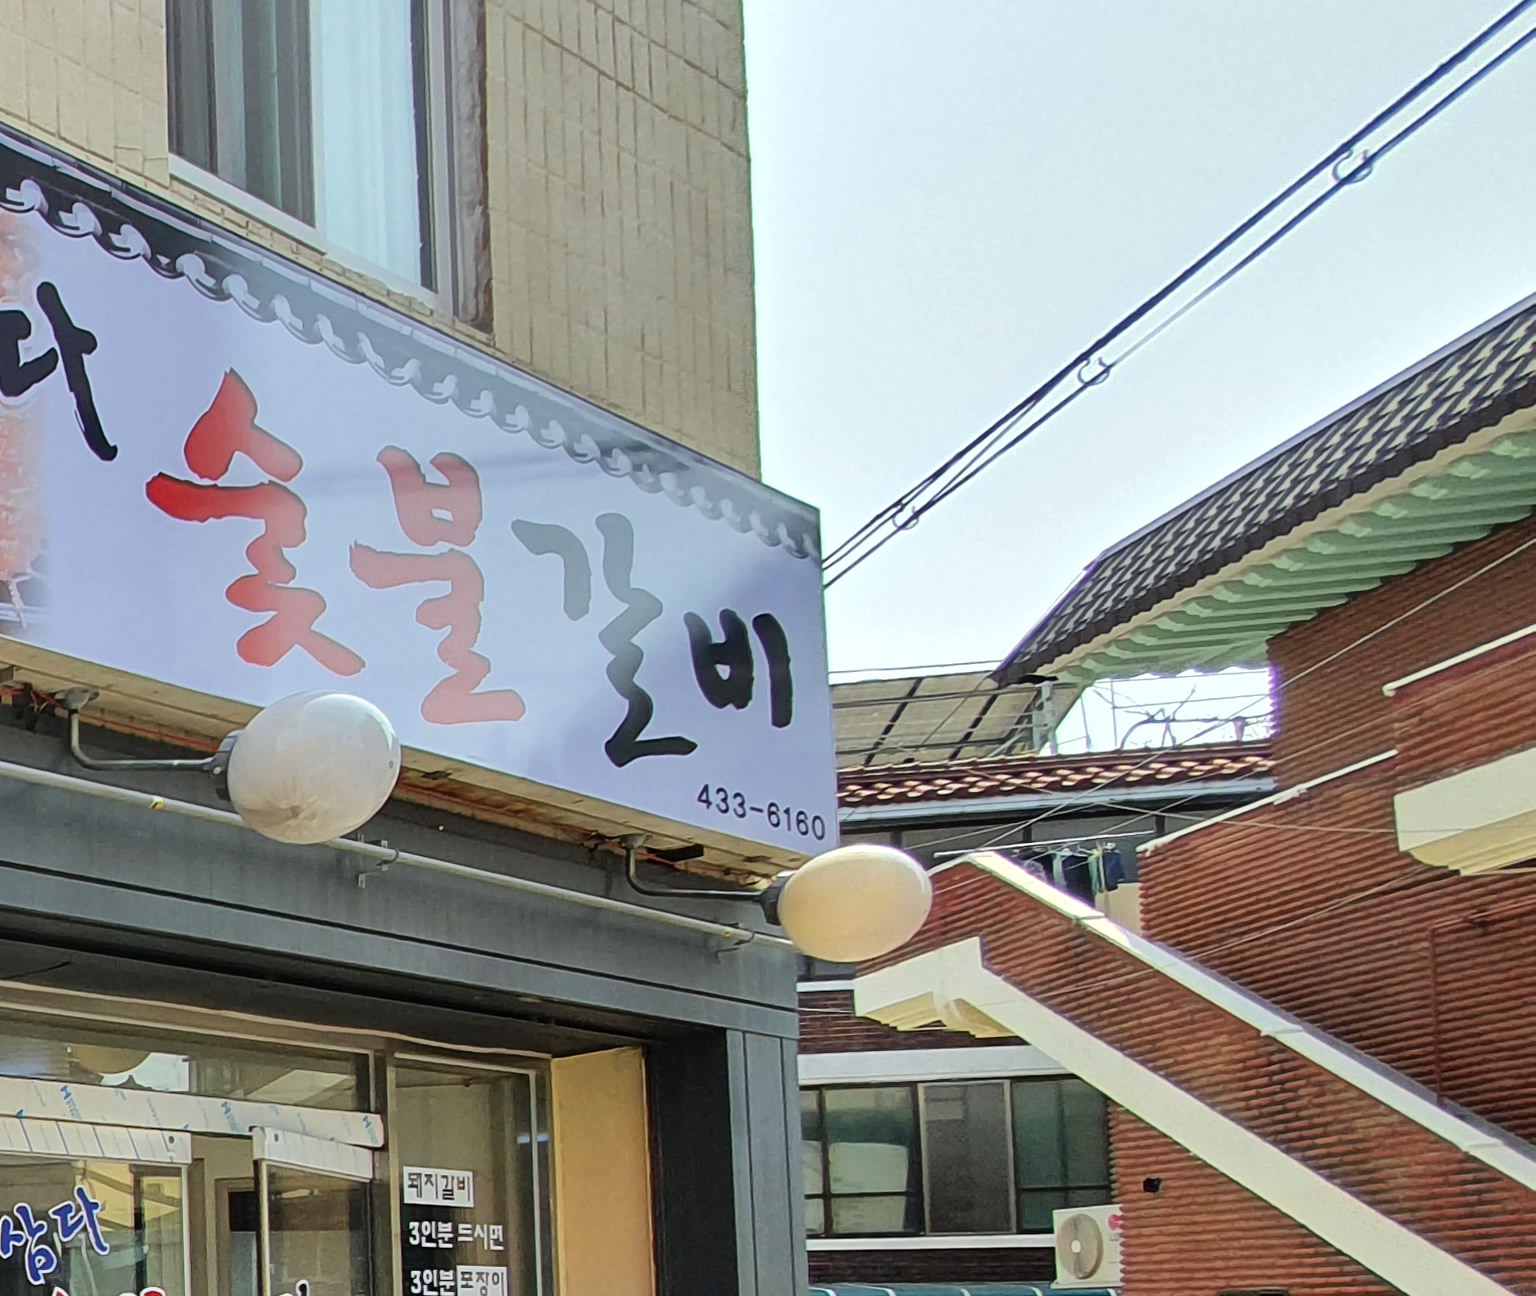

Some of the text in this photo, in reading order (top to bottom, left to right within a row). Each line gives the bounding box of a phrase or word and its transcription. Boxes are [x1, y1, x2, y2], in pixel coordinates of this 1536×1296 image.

[696, 783, 827, 841] 433-6160
[407, 1172, 471, 1202] 돼지갈비
[409, 1220, 505, 1250] 3인분 드시면
[410, 1268, 456, 1296] 3인분
